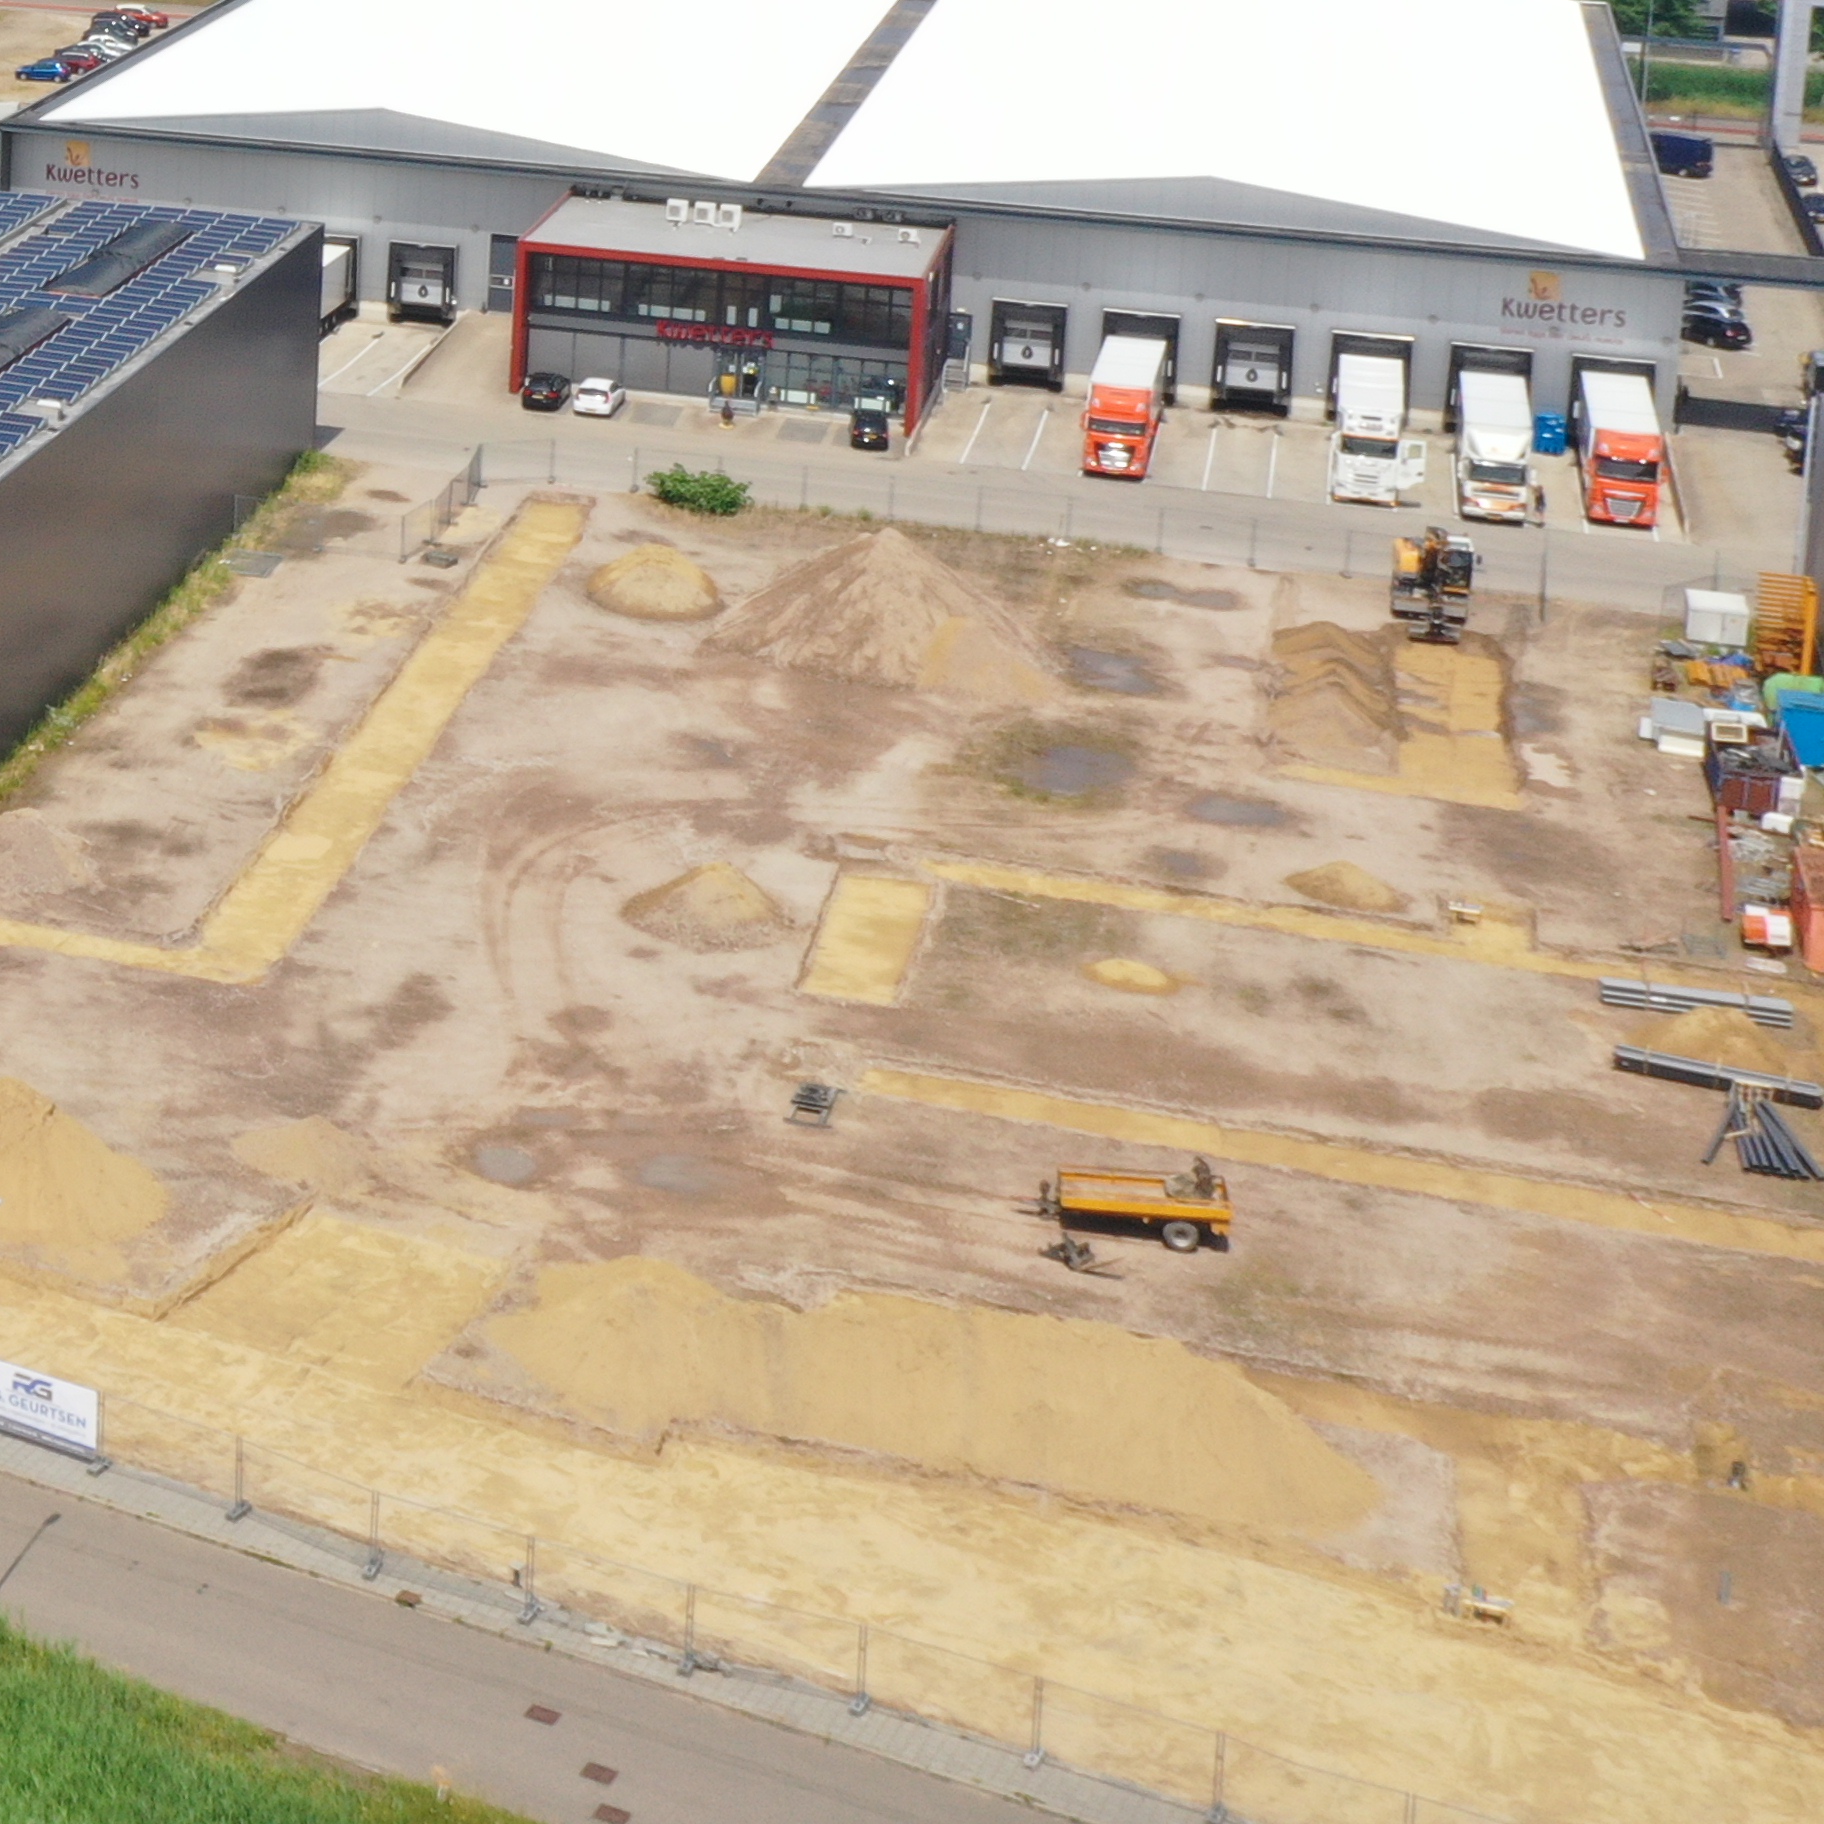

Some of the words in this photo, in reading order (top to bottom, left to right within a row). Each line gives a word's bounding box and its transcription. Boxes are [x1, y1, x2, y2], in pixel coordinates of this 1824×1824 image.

[46, 164, 139, 189] Kwetters
[1502, 297, 1627, 328] Kwetters
[657, 319, 777, 349] Kwetters
[8, 1393, 88, 1429] GEURTSEN
